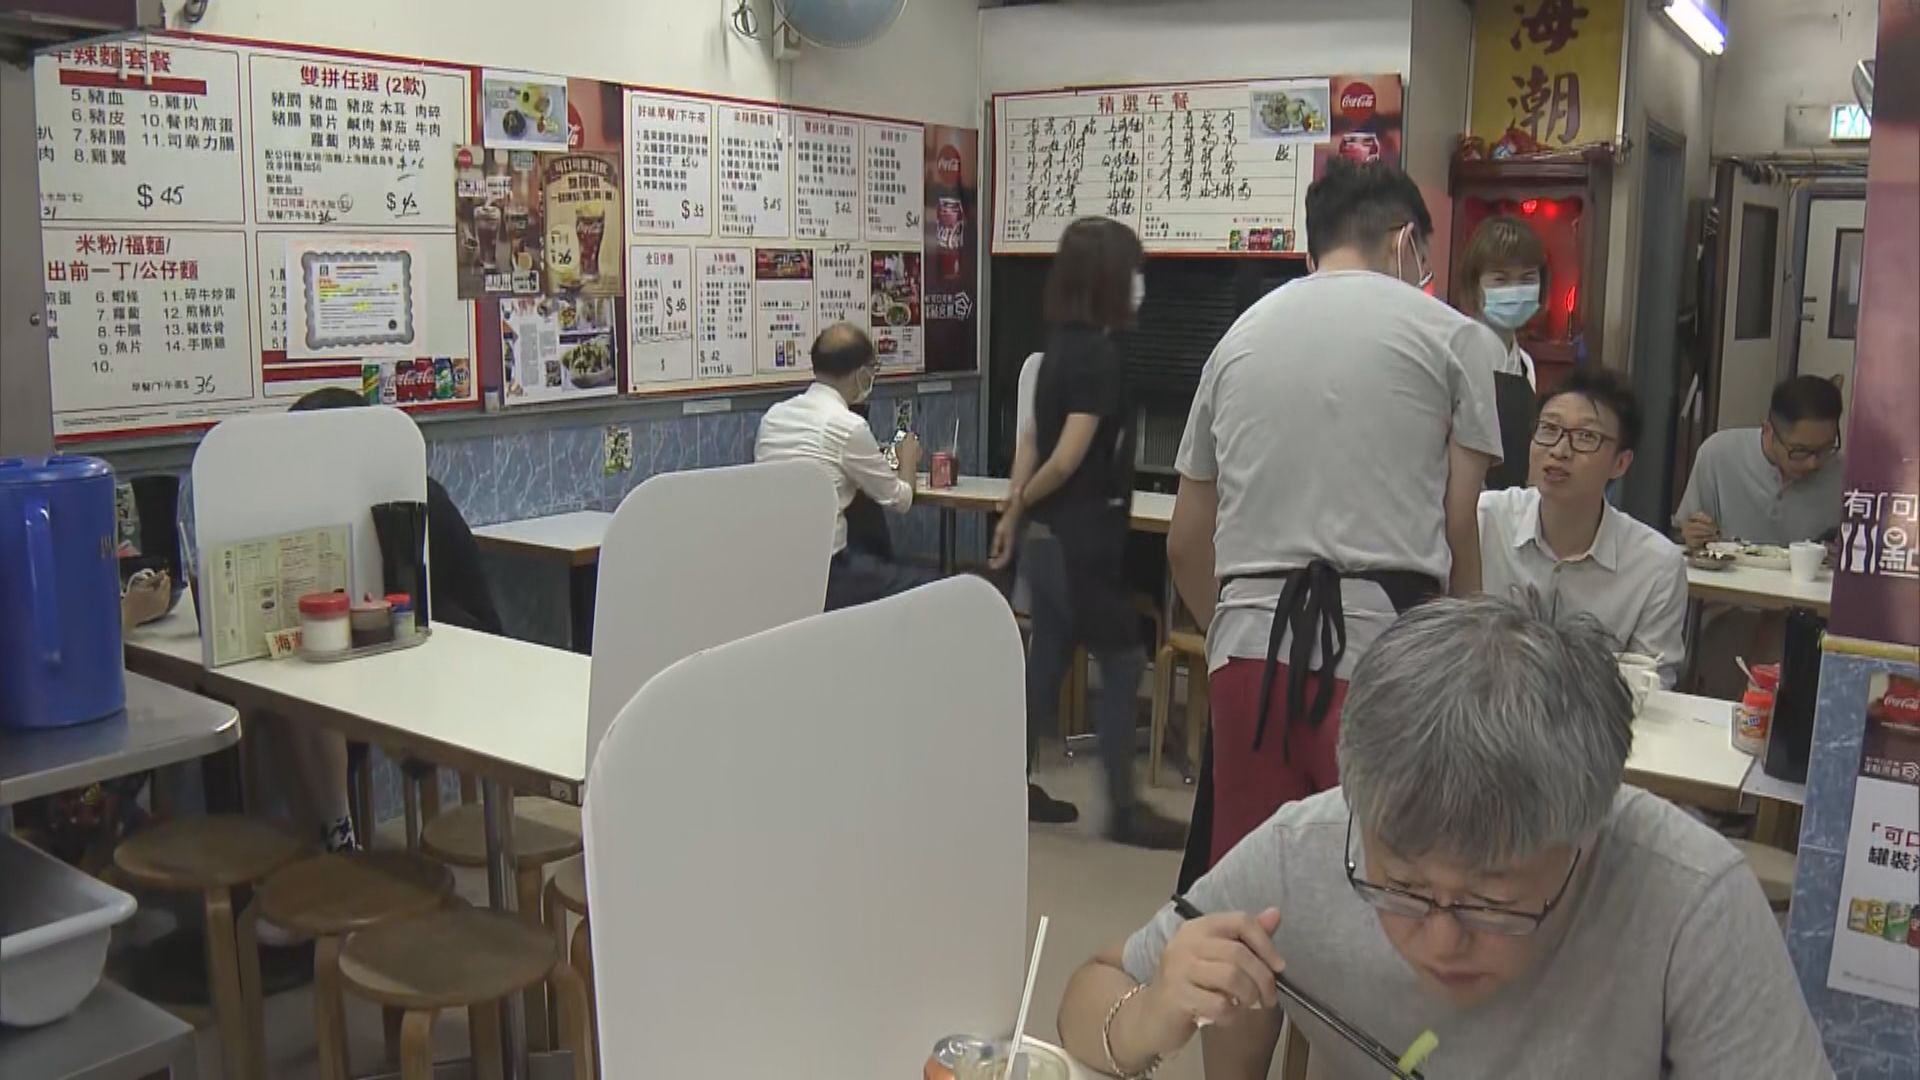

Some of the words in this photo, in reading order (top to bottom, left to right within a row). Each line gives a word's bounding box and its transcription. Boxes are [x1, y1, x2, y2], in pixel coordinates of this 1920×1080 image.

[301, 65, 379, 92] 雙拼任選
[1508, 0, 1590, 144] 海潮
[137, 183, 153, 209] $
[160, 185, 185, 206] 45
[386, 192, 396, 211] $
[681, 200, 690, 219] $
[48, 260, 199, 282] 出前一丁/公仔麵
[92, 361, 113, 373] 10.
